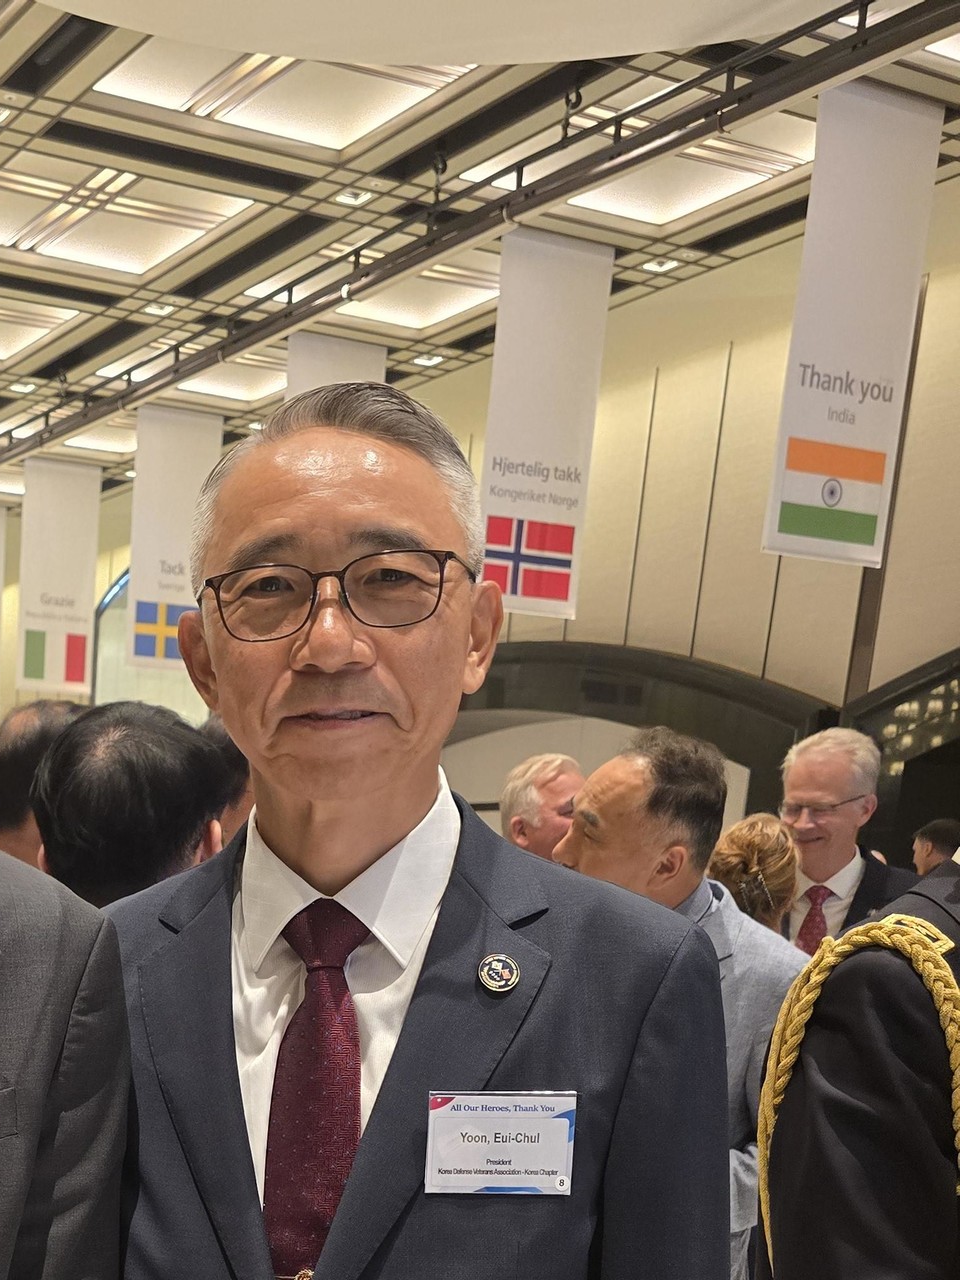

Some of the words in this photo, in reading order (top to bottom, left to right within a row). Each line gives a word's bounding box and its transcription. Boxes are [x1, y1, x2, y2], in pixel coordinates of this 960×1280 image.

[799, 362, 856, 397] Thank
[858, 379, 894, 405] you
[828, 406, 856, 425] India
[492, 456, 550, 482] Hjertelig
[553, 465, 582, 484] takk
[489, 484, 547, 504] Kongeriket
[548, 492, 579, 510] Norge
[159, 560, 185, 576] Tack
[450, 1104, 462, 1112] All
[463, 1104, 479, 1112] Our
[481, 1104, 511, 1113] Heroes,
[513, 1104, 539, 1112] Thank
[540, 1104, 556, 1112] You
[460, 1132, 490, 1145] Yoon,
[493, 1132, 540, 1144] Eui-Chul
[486, 1158, 512, 1166] President
[473, 1168, 494, 1176] Veterans
[494, 1168, 522, 1176] Association
[539, 1169, 558, 1177] Chapter
[558, 1178, 565, 1187] 8
